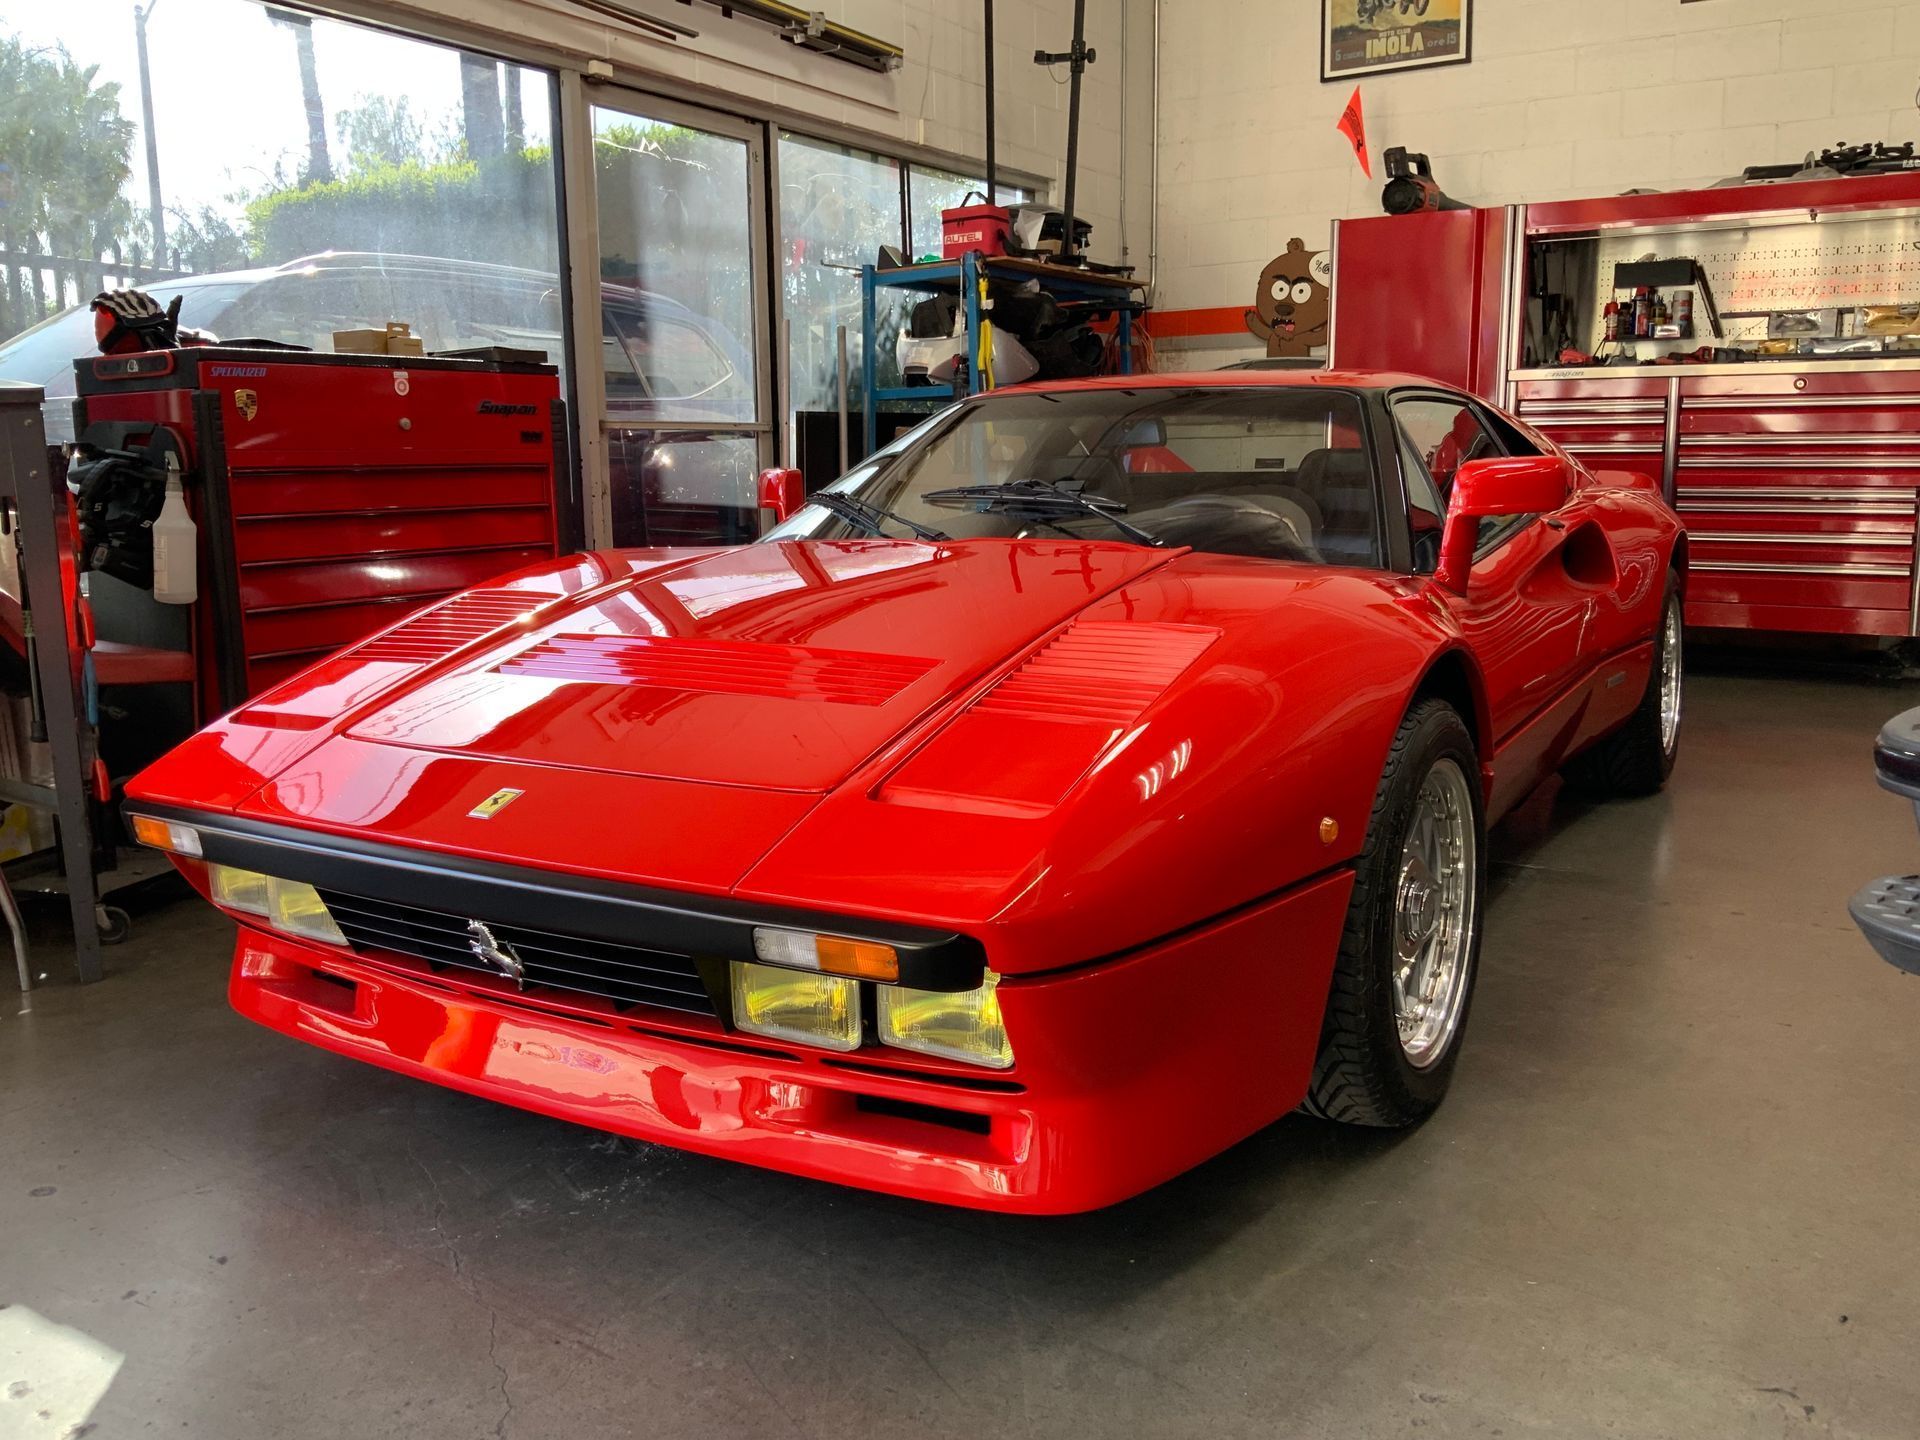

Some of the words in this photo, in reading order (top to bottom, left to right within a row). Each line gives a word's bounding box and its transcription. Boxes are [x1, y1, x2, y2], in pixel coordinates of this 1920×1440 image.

[1365, 31, 1424, 59] IMOLA
[1427, 38, 1445, 48] ore
[945, 232, 980, 243] AUTEL
[210, 367, 267, 377] SPECIALIZED
